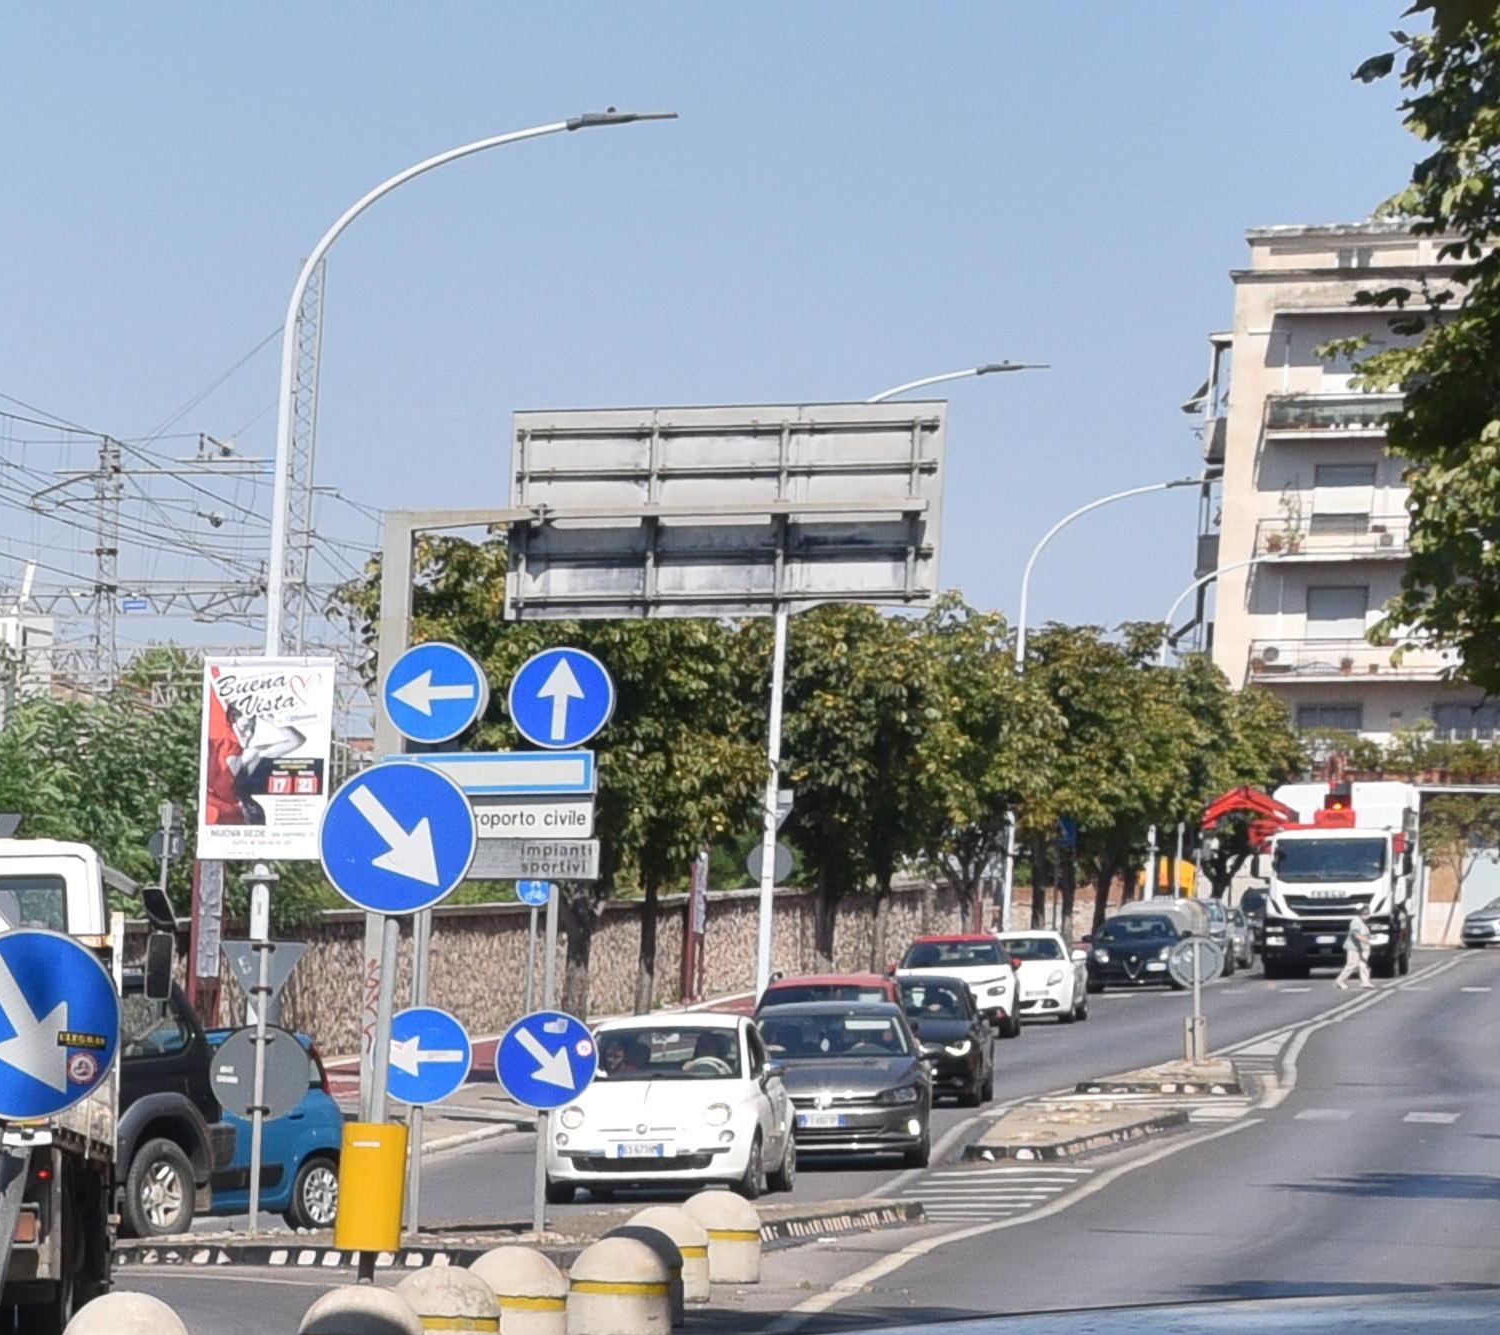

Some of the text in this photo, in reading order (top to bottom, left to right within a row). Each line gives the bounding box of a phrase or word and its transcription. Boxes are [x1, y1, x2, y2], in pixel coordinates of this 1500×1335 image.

[217, 674, 288, 697] Buena
[543, 809, 587, 826] civile
[521, 843, 592, 857] impianti
[521, 860, 586, 875] sportivi
